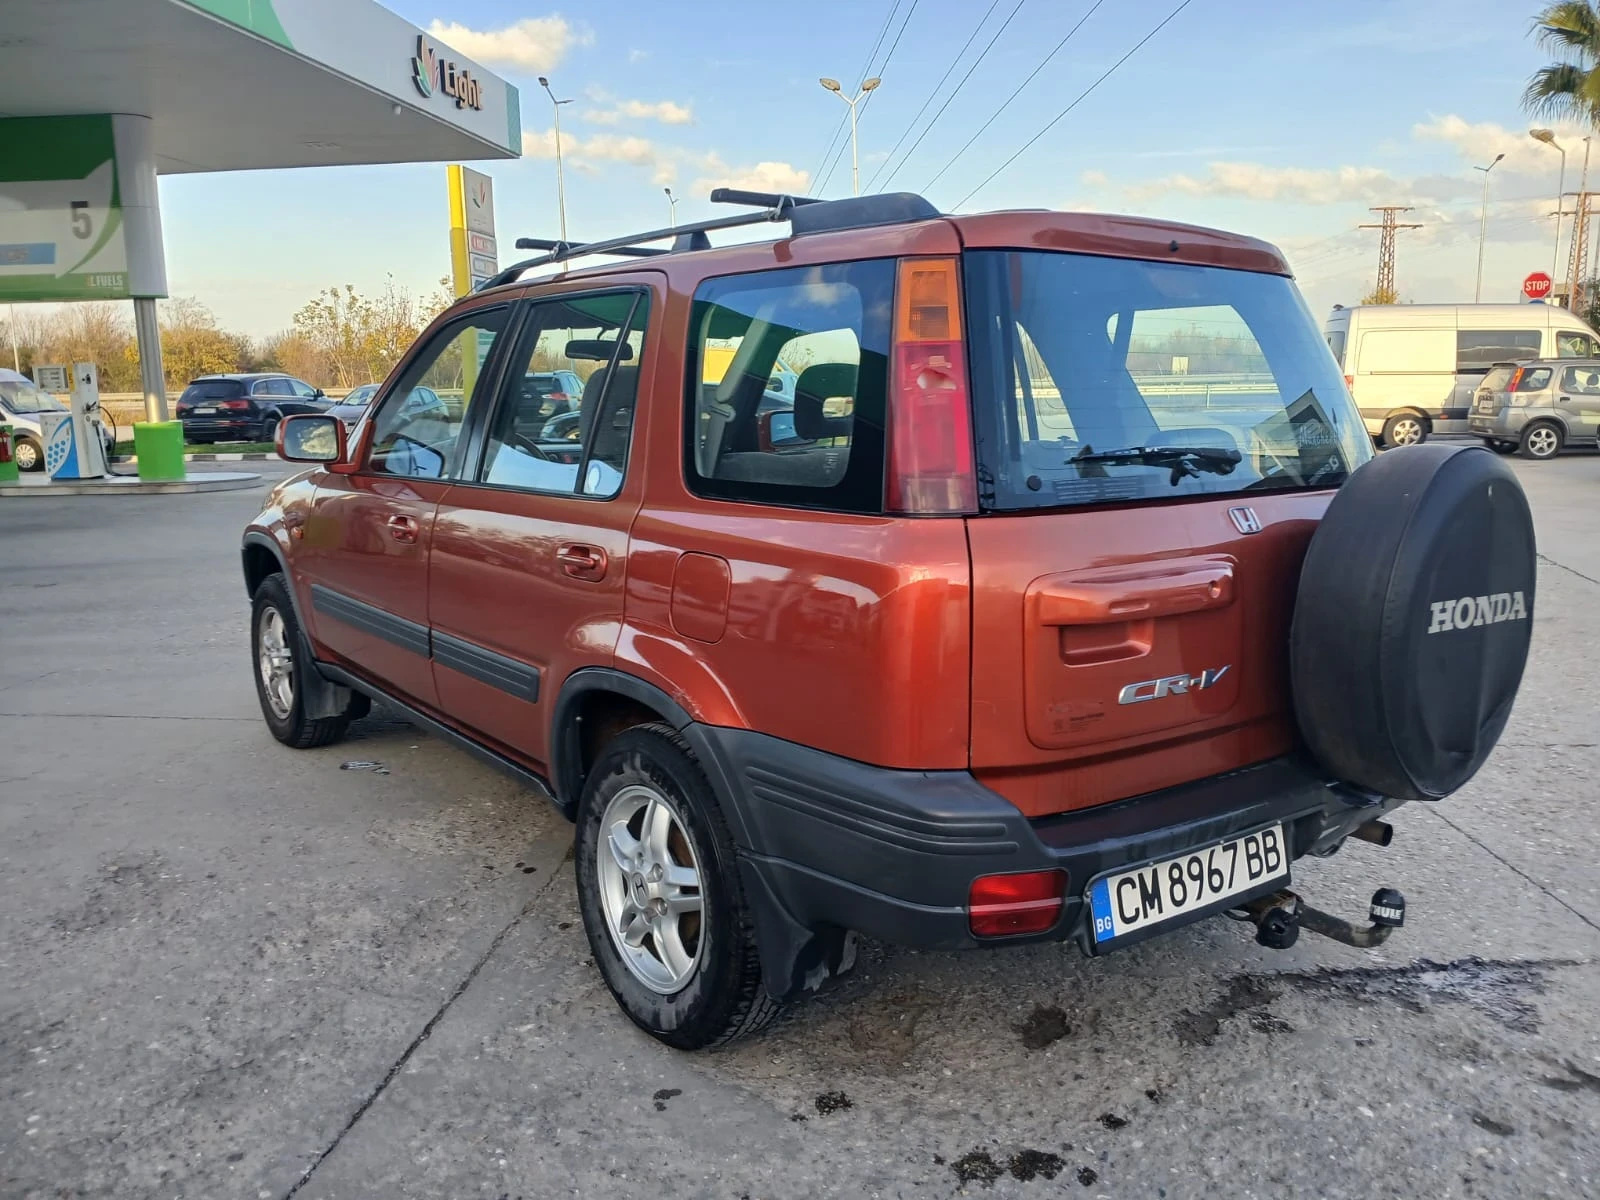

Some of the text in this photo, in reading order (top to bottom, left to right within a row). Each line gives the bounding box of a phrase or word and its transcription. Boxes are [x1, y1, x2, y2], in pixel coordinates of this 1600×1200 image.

[440, 59, 483, 110] Light
[71, 200, 92, 239] 5
[1526, 280, 1549, 291] STOP
[1428, 592, 1527, 634] HONDA
[1118, 665, 1231, 705] CR-V
[1117, 829, 1281, 925] CM 8967 BB
[1096, 916, 1112, 933] BG
